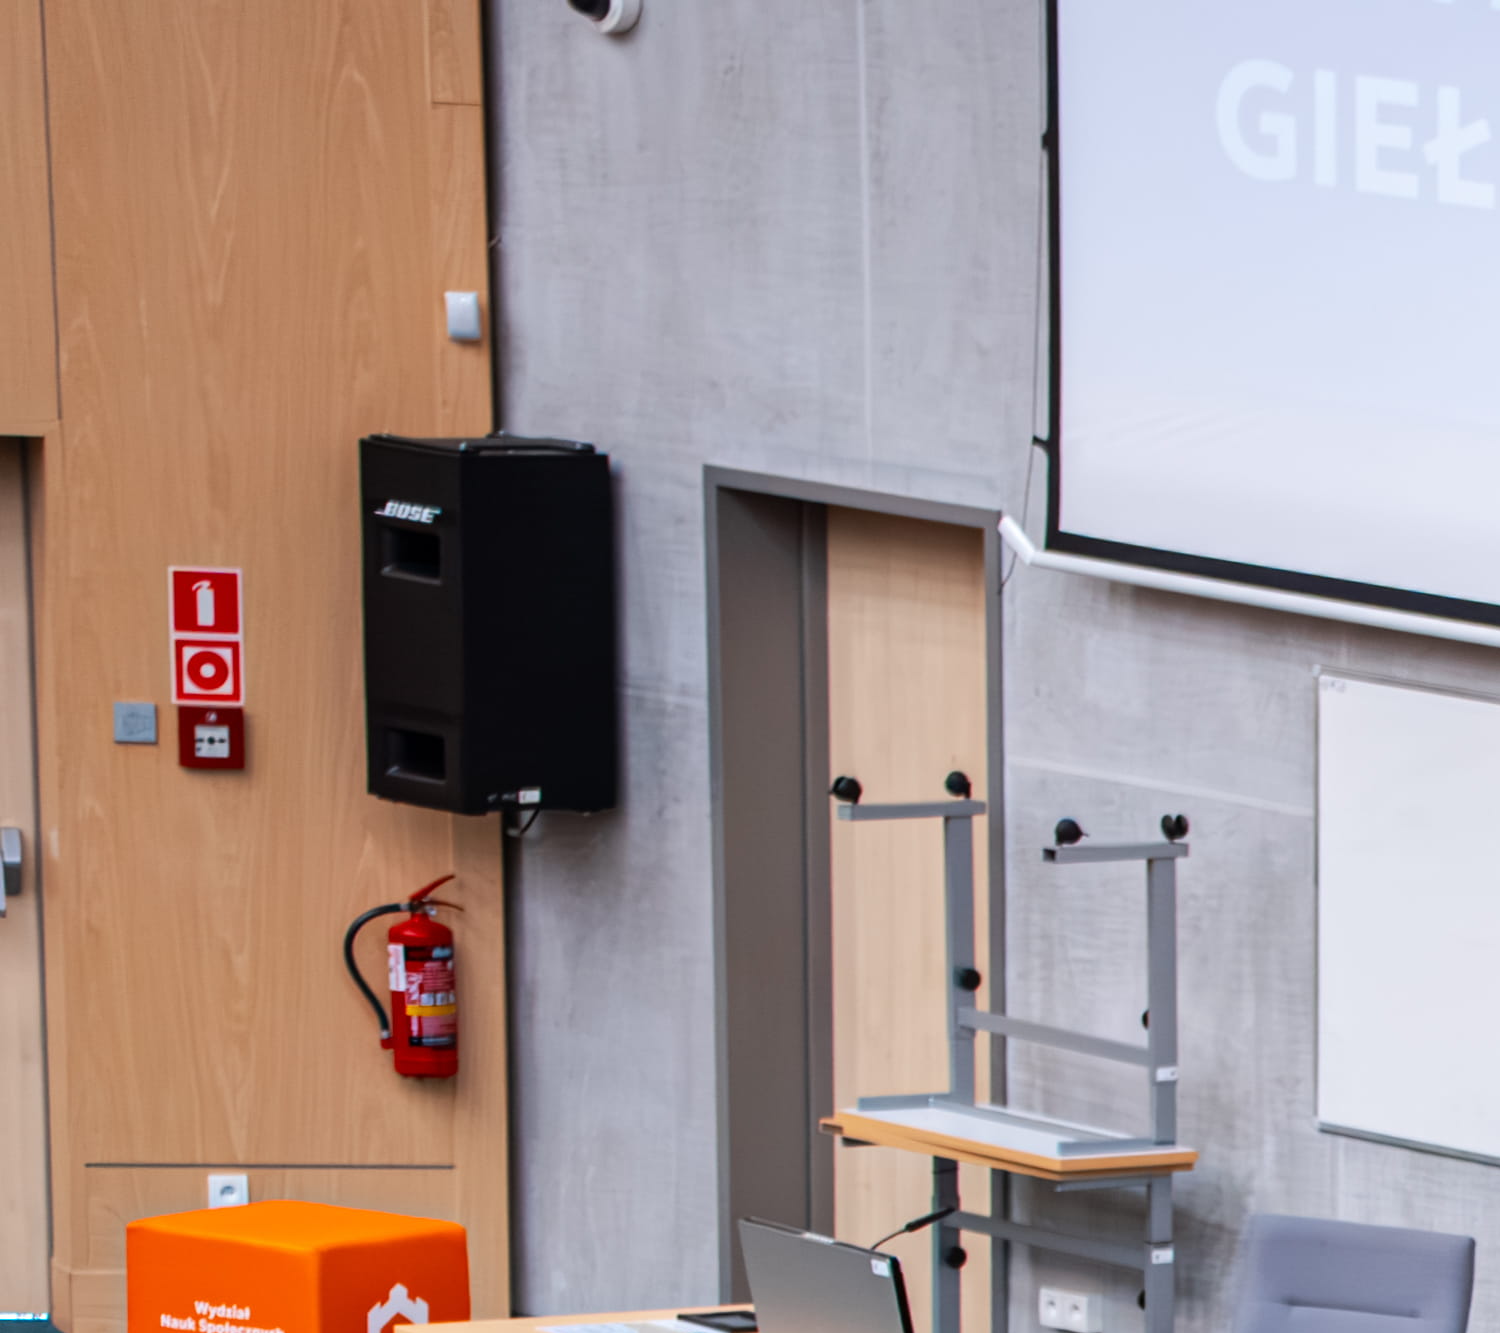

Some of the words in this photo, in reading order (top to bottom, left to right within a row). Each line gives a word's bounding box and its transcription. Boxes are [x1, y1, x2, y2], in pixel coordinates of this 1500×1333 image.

[374, 499, 442, 524] BOSE
[194, 1300, 251, 1320] Wydział
[160, 1314, 196, 1331] Nauk
